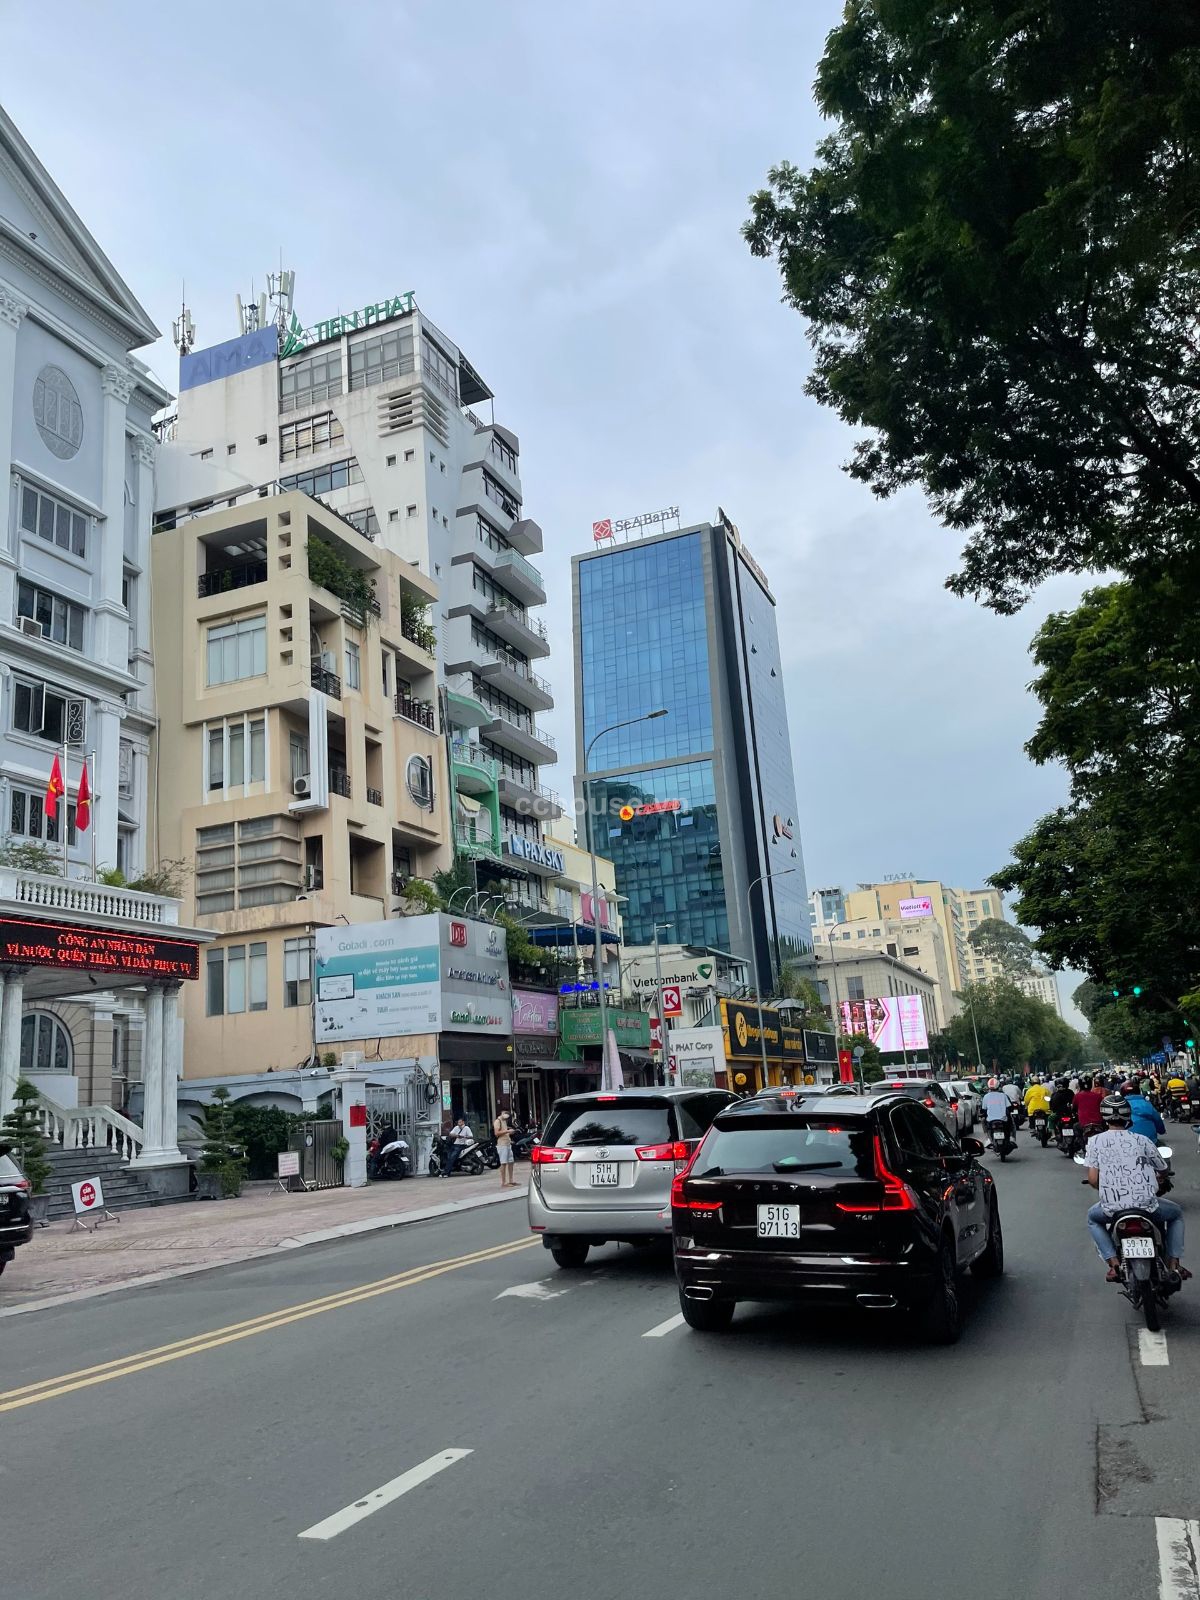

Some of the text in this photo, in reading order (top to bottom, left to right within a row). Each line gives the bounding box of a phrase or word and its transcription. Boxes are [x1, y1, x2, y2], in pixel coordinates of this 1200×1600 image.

[314, 290, 415, 341] TIEN PHAT
[615, 506, 680, 532] SeABank
[544, 849, 564, 871] SKY
[58, 933, 89, 948] CÔNG
[90, 938, 105, 949] AN
[106, 939, 136, 953] NHÂN
[633, 972, 698, 988] Vietcombank
[695, 1041, 713, 1052] Corp
[596, 1163, 612, 1174] 51H
[768, 1207, 790, 1221] 51G
[759, 1222, 798, 1236] 971.13
